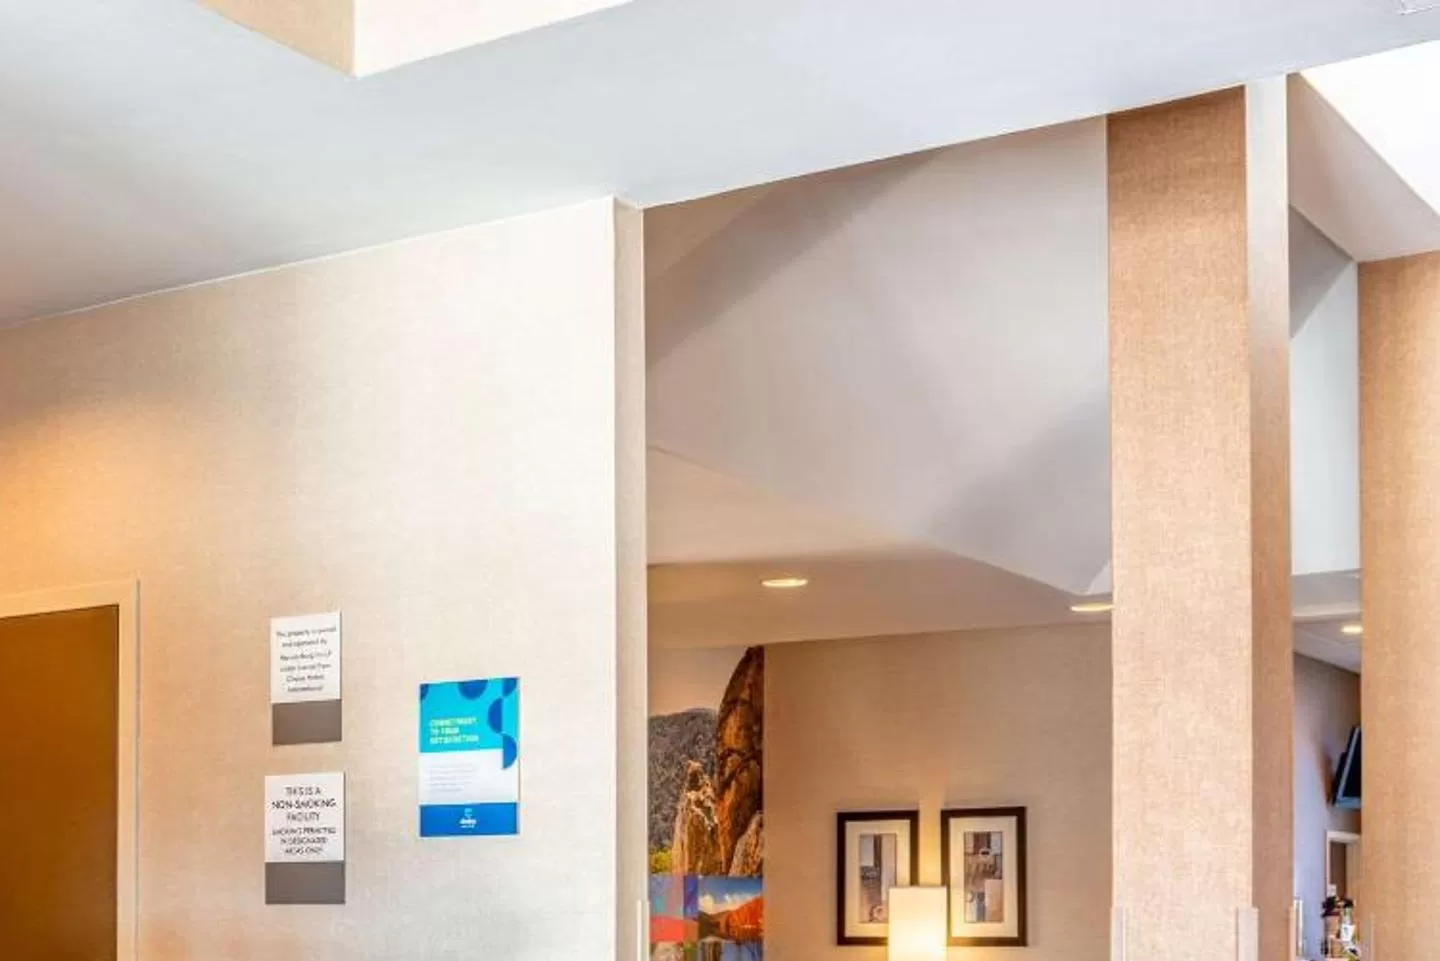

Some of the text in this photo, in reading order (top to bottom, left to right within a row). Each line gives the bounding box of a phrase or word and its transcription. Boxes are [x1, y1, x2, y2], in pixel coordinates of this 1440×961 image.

[285, 786, 322, 796] THIS IS A
[272, 798, 337, 809] NON-SMOKING
[286, 812, 321, 821] FACILITY
